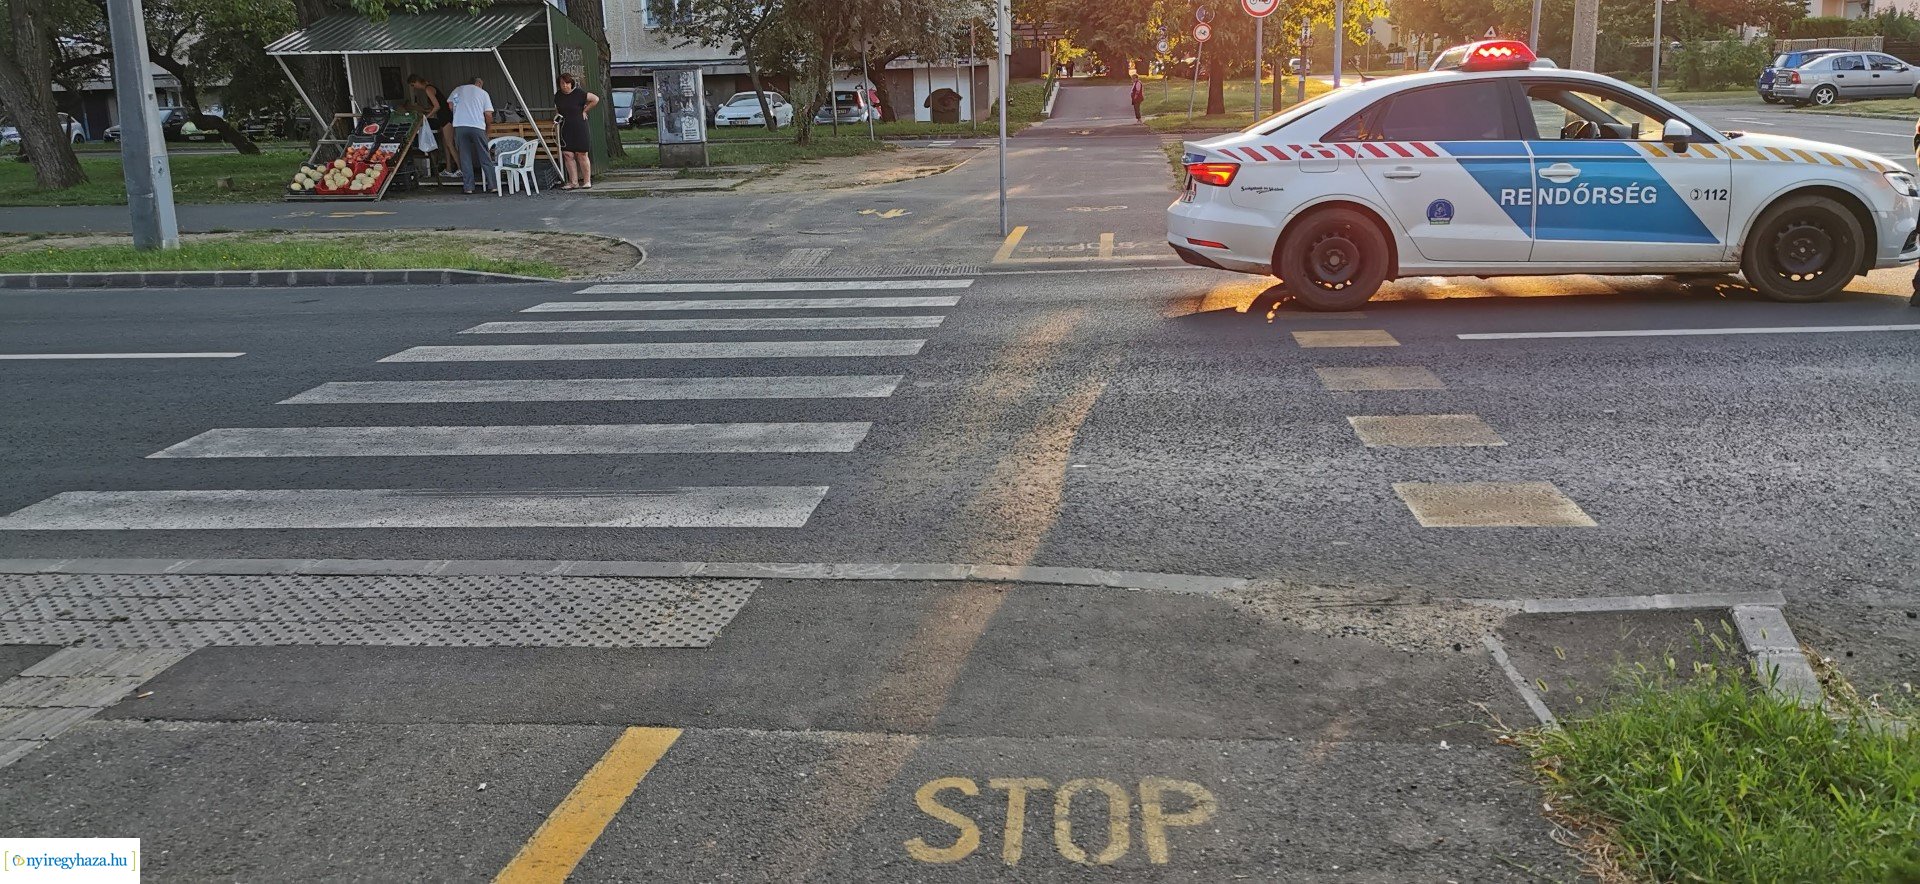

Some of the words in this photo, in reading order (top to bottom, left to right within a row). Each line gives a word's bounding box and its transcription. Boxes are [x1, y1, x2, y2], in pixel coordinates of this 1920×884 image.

[1500, 182, 1658, 206] RENDŐRSÉG
[1704, 188, 1728, 201] 112
[903, 776, 1218, 866] STOP
